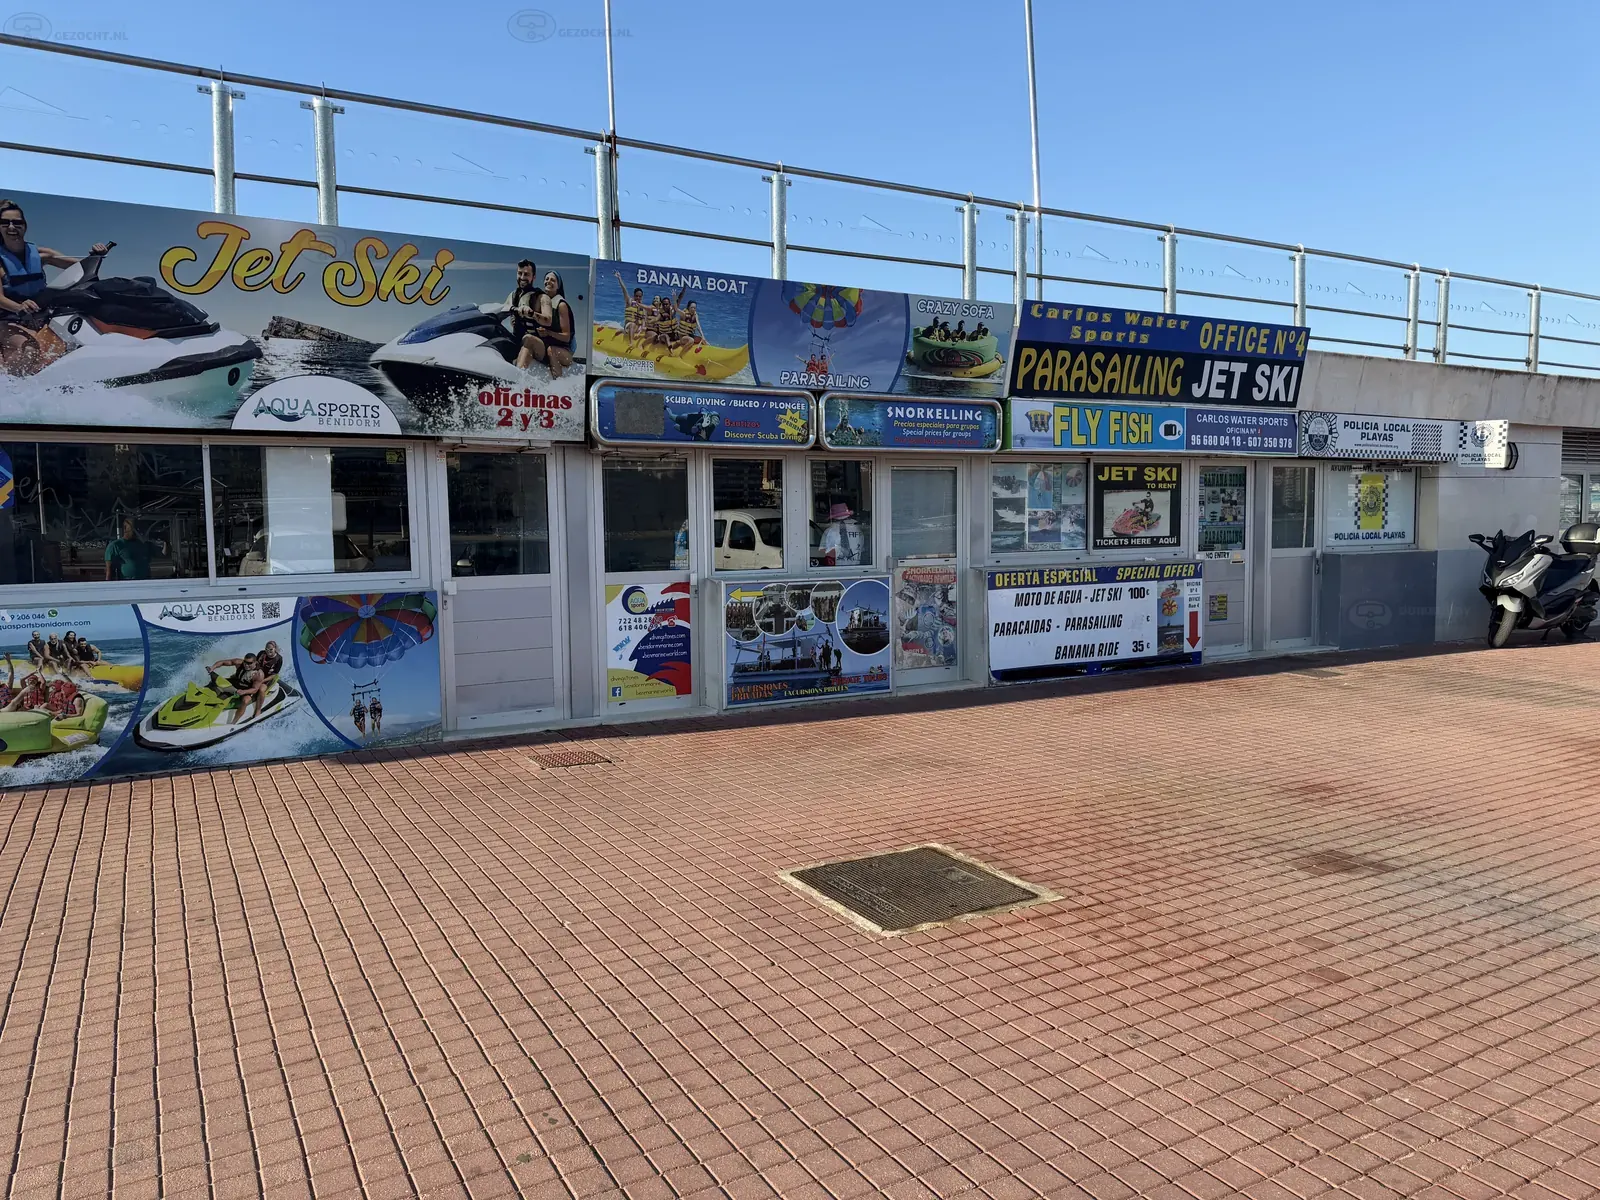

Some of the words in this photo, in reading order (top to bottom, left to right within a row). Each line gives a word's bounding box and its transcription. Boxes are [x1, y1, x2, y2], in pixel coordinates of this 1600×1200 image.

[159, 220, 337, 295] Jet
[322, 236, 455, 307] Ski
[636, 268, 703, 290] BANANA
[707, 277, 749, 295] BOAT
[917, 299, 958, 316] CRAZY
[961, 302, 995, 319] SOFA
[1030, 303, 1112, 324] Carlos
[1124, 311, 1190, 331] Water
[1070, 325, 1150, 344] Sports
[1200, 321, 1270, 354] OFFICE
[780, 370, 872, 390] PARASAILING
[1016, 347, 1184, 397] PARASAILING
[1191, 360, 1248, 400] JET
[1252, 363, 1300, 402] SKI
[478, 387, 573, 410] oficinas
[665, 395, 693, 405] SCUBA
[696, 397, 726, 406] DIVING
[497, 407, 513, 427] 2
[520, 413, 533, 431] y
[540, 409, 555, 428] 3
[886, 406, 983, 420] SNORKELLING
[1196, 414, 1230, 424] CARLOS
[1230, 416, 1258, 426] WATER
[1258, 416, 1289, 427] SPORTS
[318, 418, 381, 428] BENIDORM
[893, 419, 916, 428] Precios
[916, 421, 945, 430] especiales
[1052, 406, 1104, 447] FLY
[1108, 410, 1153, 445] FISH
[1343, 420, 1379, 431] POLICIA
[1383, 423, 1411, 433] LOCAL
[724, 430, 756, 439] Discover
[757, 431, 779, 440] Scuba
[902, 428, 924, 437] Special
[924, 429, 942, 437] prices
[942, 430, 951, 438] for
[1190, 434, 1201, 446] 96
[1203, 435, 1218, 446] 680
[1219, 435, 1230, 447] 04
[1231, 436, 1241, 447] 18
[1247, 436, 1262, 447] 607
[1263, 437, 1278, 448] 350
[1278, 437, 1293, 448] 978
[1360, 432, 1394, 442] PLAYAS
[1097, 466, 1138, 481] JET
[1143, 466, 1178, 482] SKI
[1096, 538, 1129, 546] TICKETS
[1130, 537, 1152, 545] HERE
[1334, 533, 1360, 541] POLICIA
[1361, 532, 1382, 540] LOCAL
[1383, 531, 1406, 539] PLAYAS
[995, 571, 1040, 587] OFERTA
[1043, 569, 1098, 585] ESPECIAL
[1116, 565, 1161, 581] SPECIAL
[1163, 564, 1195, 578] OFFER
[1014, 592, 1043, 607] MOTO
[1044, 591, 1057, 606] DE
[1057, 589, 1083, 605] AGUA
[1090, 589, 1107, 602] JET
[1106, 587, 1123, 601] SKI
[618, 617, 632, 625] 722
[618, 624, 633, 632] 618
[993, 618, 1053, 637] PARACAIDAS
[1064, 614, 1123, 631] PARASAILING
[1054, 643, 1096, 660] BANANA
[1097, 641, 1120, 656] RIDE
[1132, 640, 1145, 652] 35
